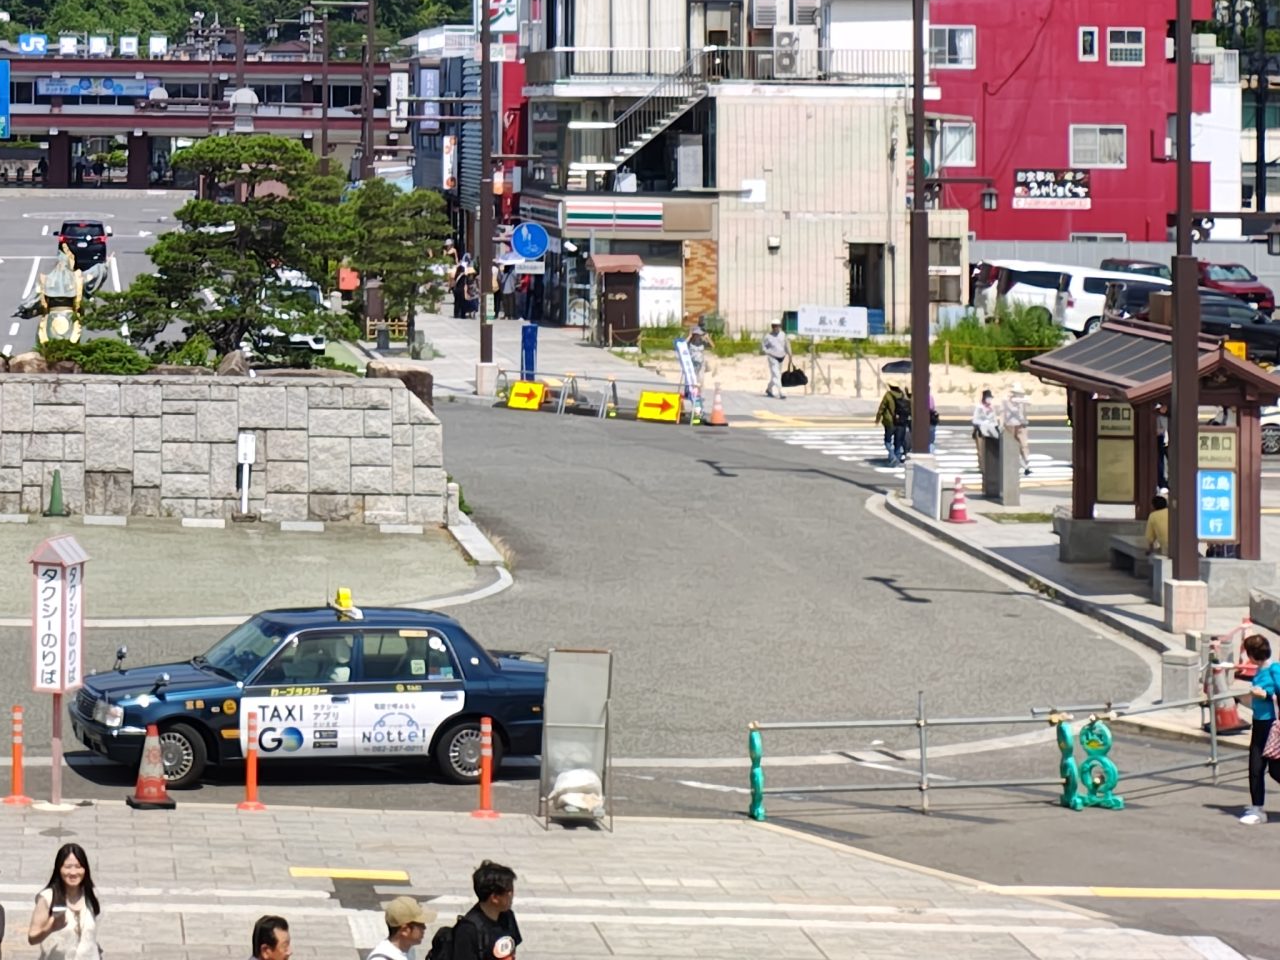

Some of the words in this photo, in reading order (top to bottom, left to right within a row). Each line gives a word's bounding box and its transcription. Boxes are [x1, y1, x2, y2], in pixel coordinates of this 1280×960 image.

[21, 39, 46, 52] JR
[1101, 407, 1131, 420] 宮島口
[1199, 436, 1232, 450] 宮島口
[1202, 477, 1230, 491] 広島
[1202, 497, 1230, 511] 空港
[1209, 518, 1223, 533] 行
[41, 568, 58, 685] タクシーのりば
[68, 566, 78, 683] タクシーのりば
[258, 704, 303, 722] TAXI
[313, 712, 339, 720] アプリ
[258, 727, 304, 753] GO
